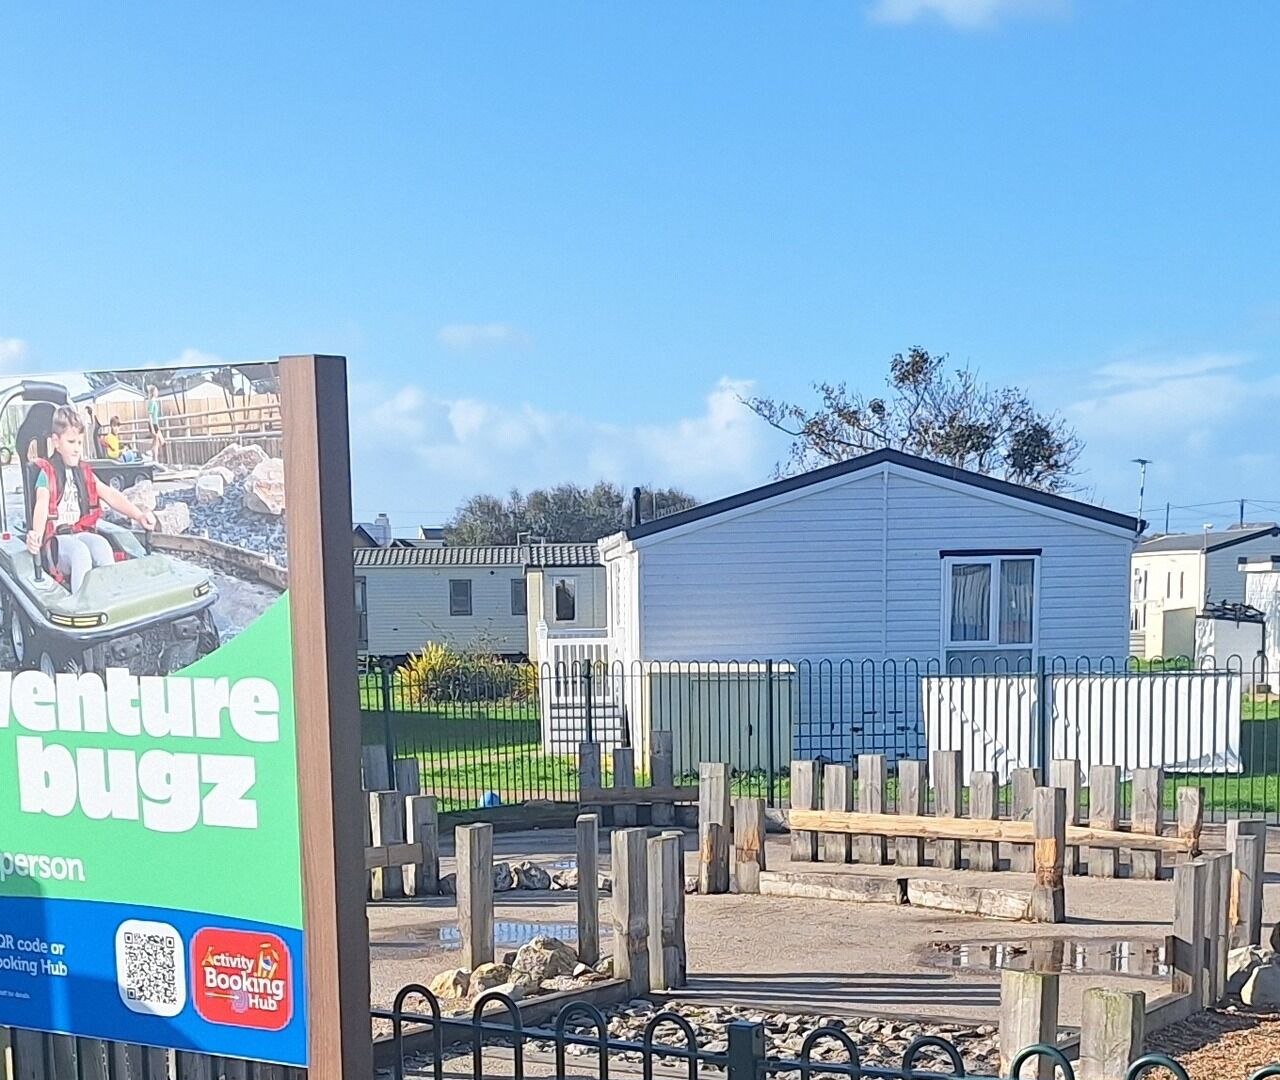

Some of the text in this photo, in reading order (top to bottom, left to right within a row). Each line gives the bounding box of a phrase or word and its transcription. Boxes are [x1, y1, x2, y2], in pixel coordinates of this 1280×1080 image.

[16, 735, 258, 832] bugz
[17, 938, 48, 953] code
[50, 943, 66, 955] or
[40, 958, 68, 977] Hub
[201, 946, 255, 973] Activity
[204, 966, 285, 1001] Booking
[248, 993, 278, 1012] Hub
